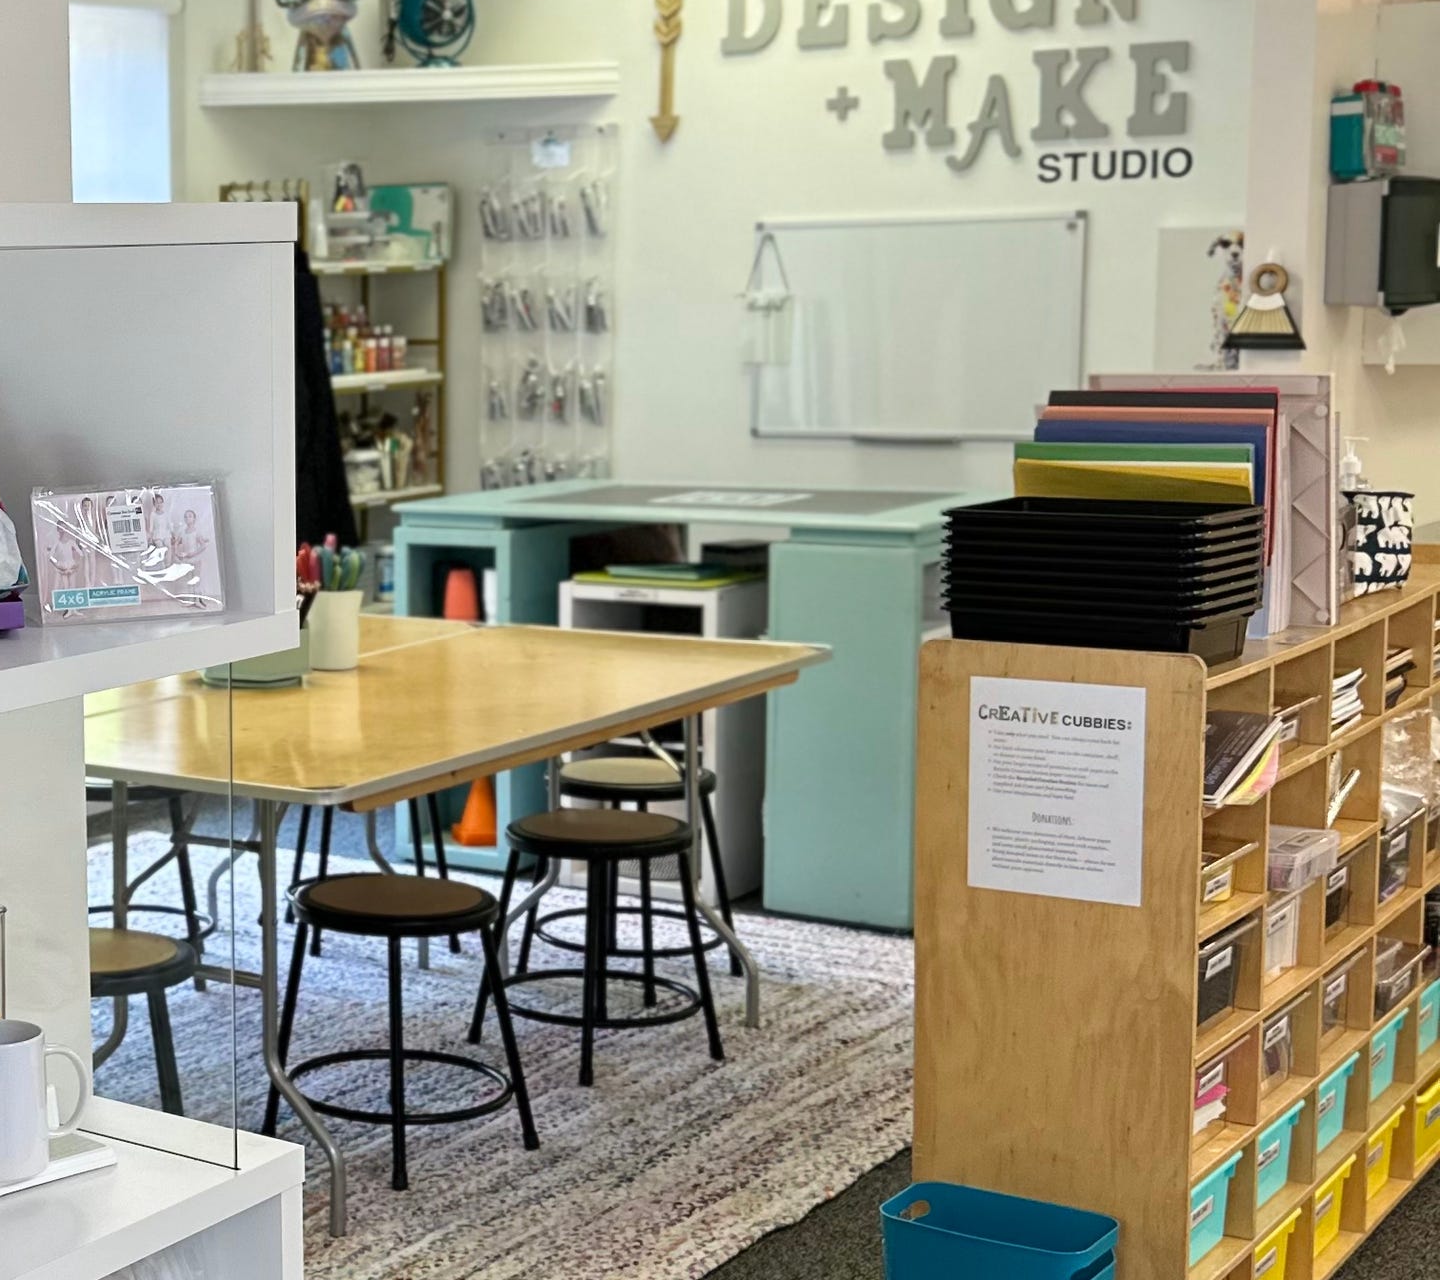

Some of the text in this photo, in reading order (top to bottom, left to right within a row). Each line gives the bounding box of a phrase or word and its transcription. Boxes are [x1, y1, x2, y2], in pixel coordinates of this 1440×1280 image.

[882, 40, 1190, 172] MAKE
[1038, 147, 1194, 183] STUDIO
[58, 592, 85, 606] 4x6
[1062, 714, 1133, 731] CUBBIES:
